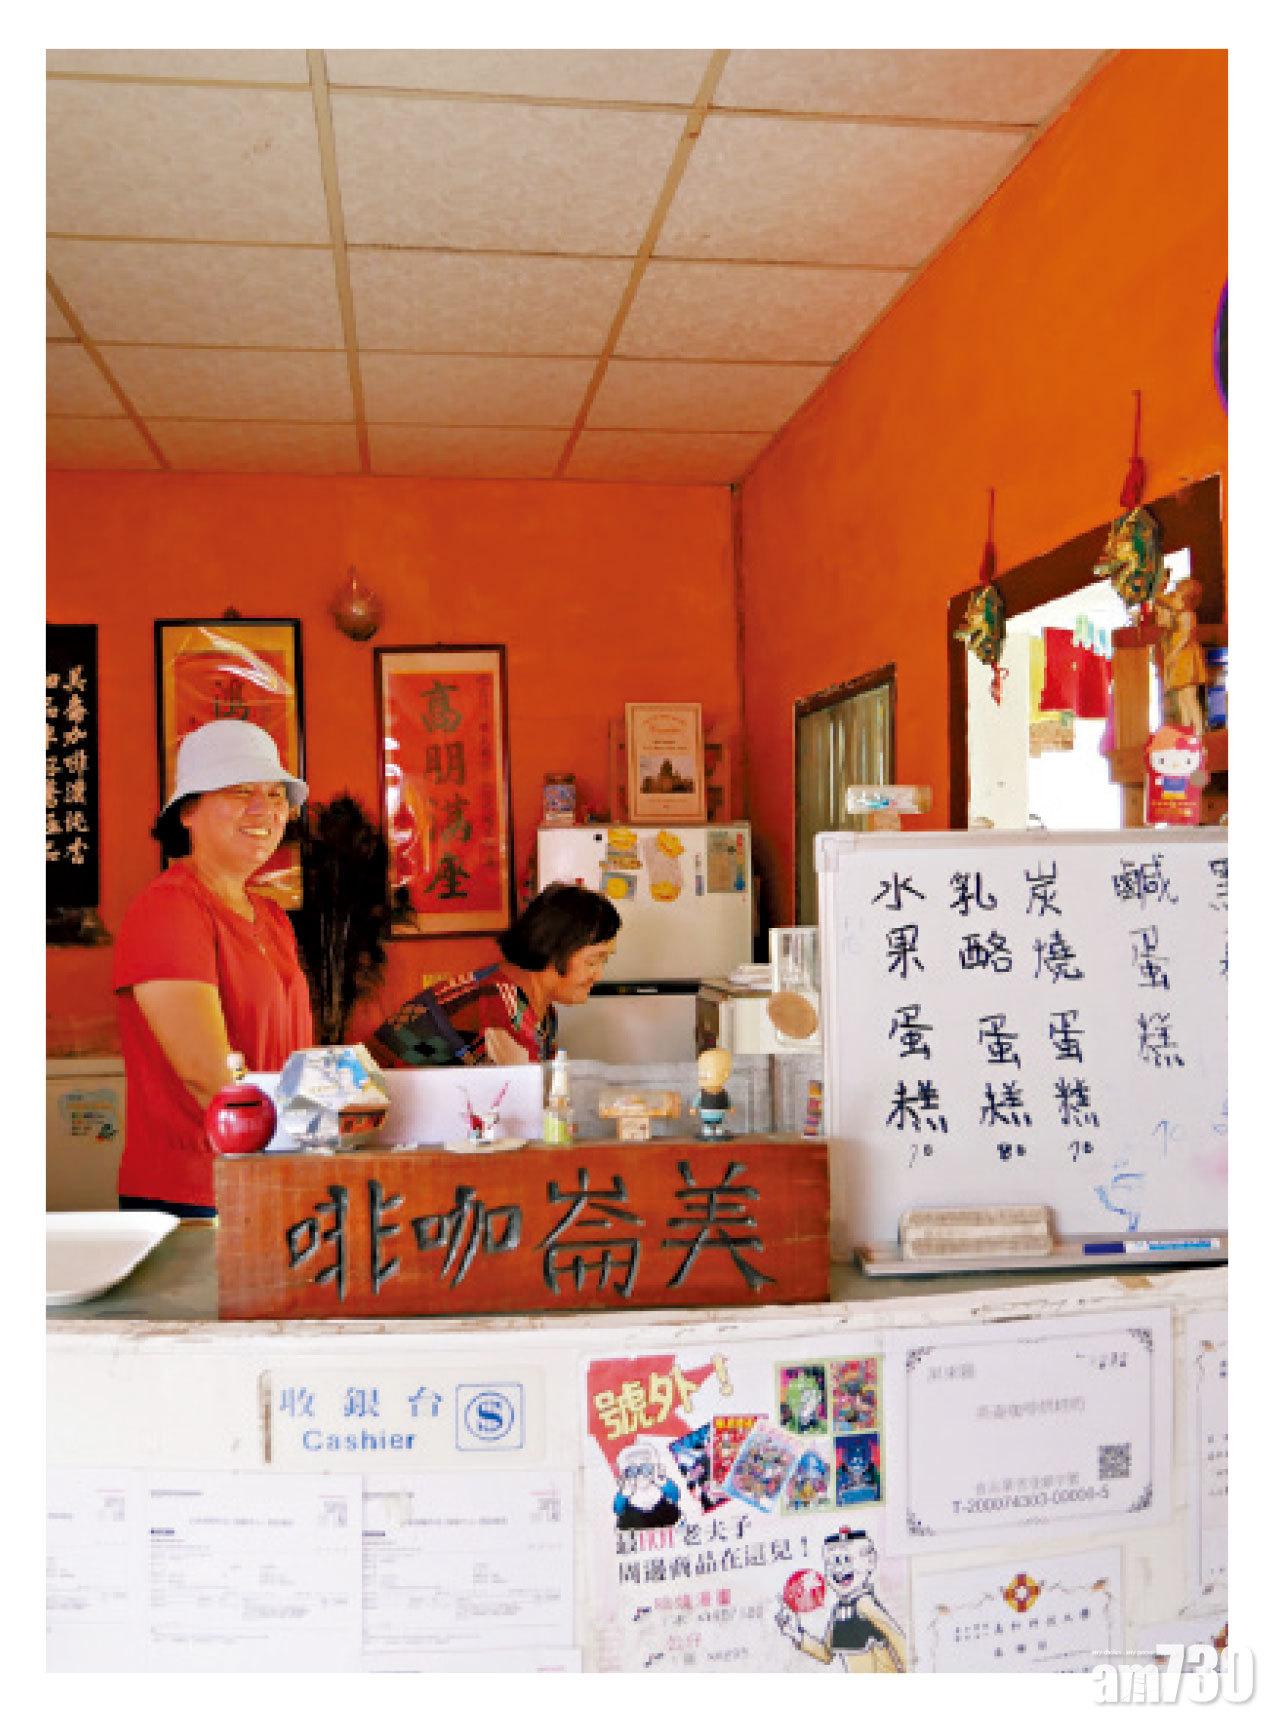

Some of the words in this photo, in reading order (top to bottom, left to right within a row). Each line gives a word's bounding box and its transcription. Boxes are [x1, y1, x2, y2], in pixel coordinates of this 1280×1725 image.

[872, 872, 949, 1132] 水果蛋糕
[948, 871, 1033, 1127] 乳酪蛋糕
[280, 1386, 443, 1417] 收銀台
[302, 1429, 416, 1451] Cashier
